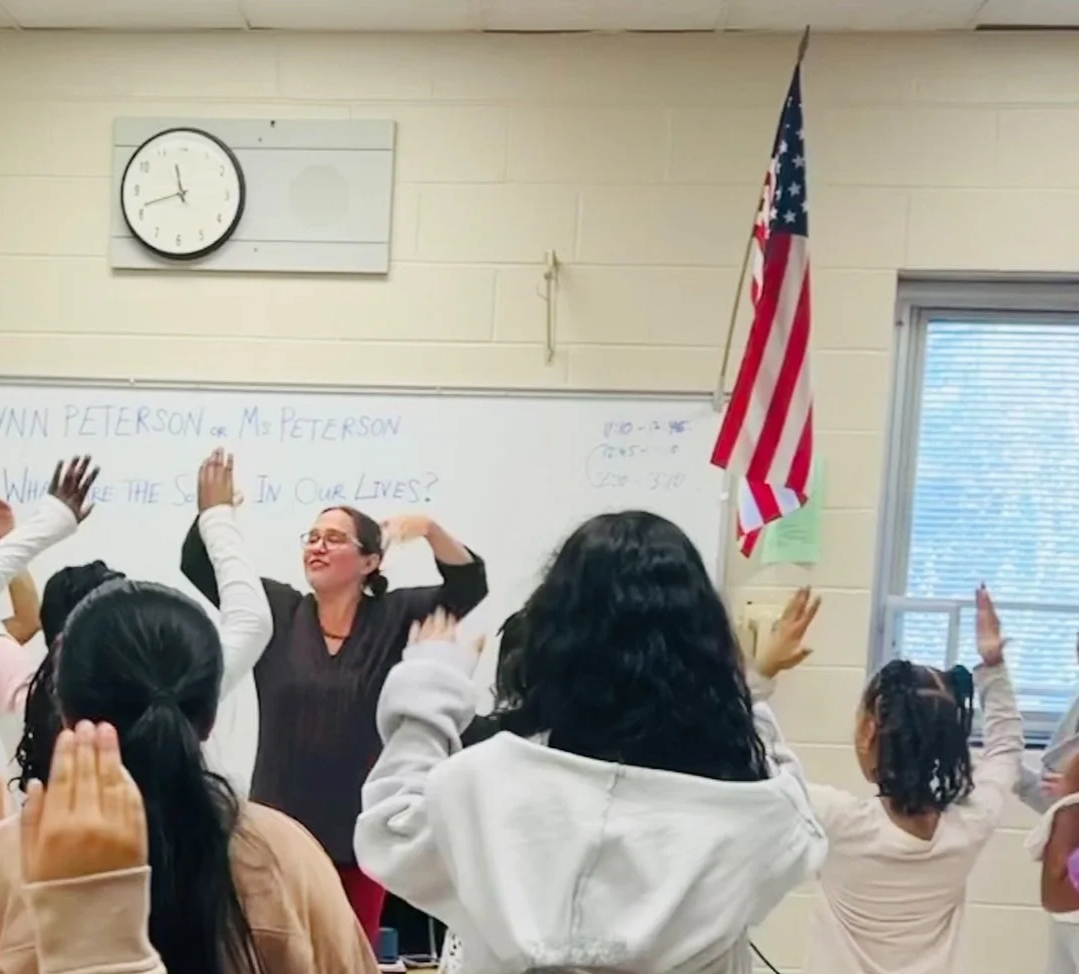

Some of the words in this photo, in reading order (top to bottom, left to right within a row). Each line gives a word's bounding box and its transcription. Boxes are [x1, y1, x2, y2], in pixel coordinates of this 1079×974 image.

[64, 404, 203, 437] PETERSON
[280, 406, 402, 443] PETERSON
[121, 479, 162, 503] THE
[354, 471, 440, 503] LIVES?
